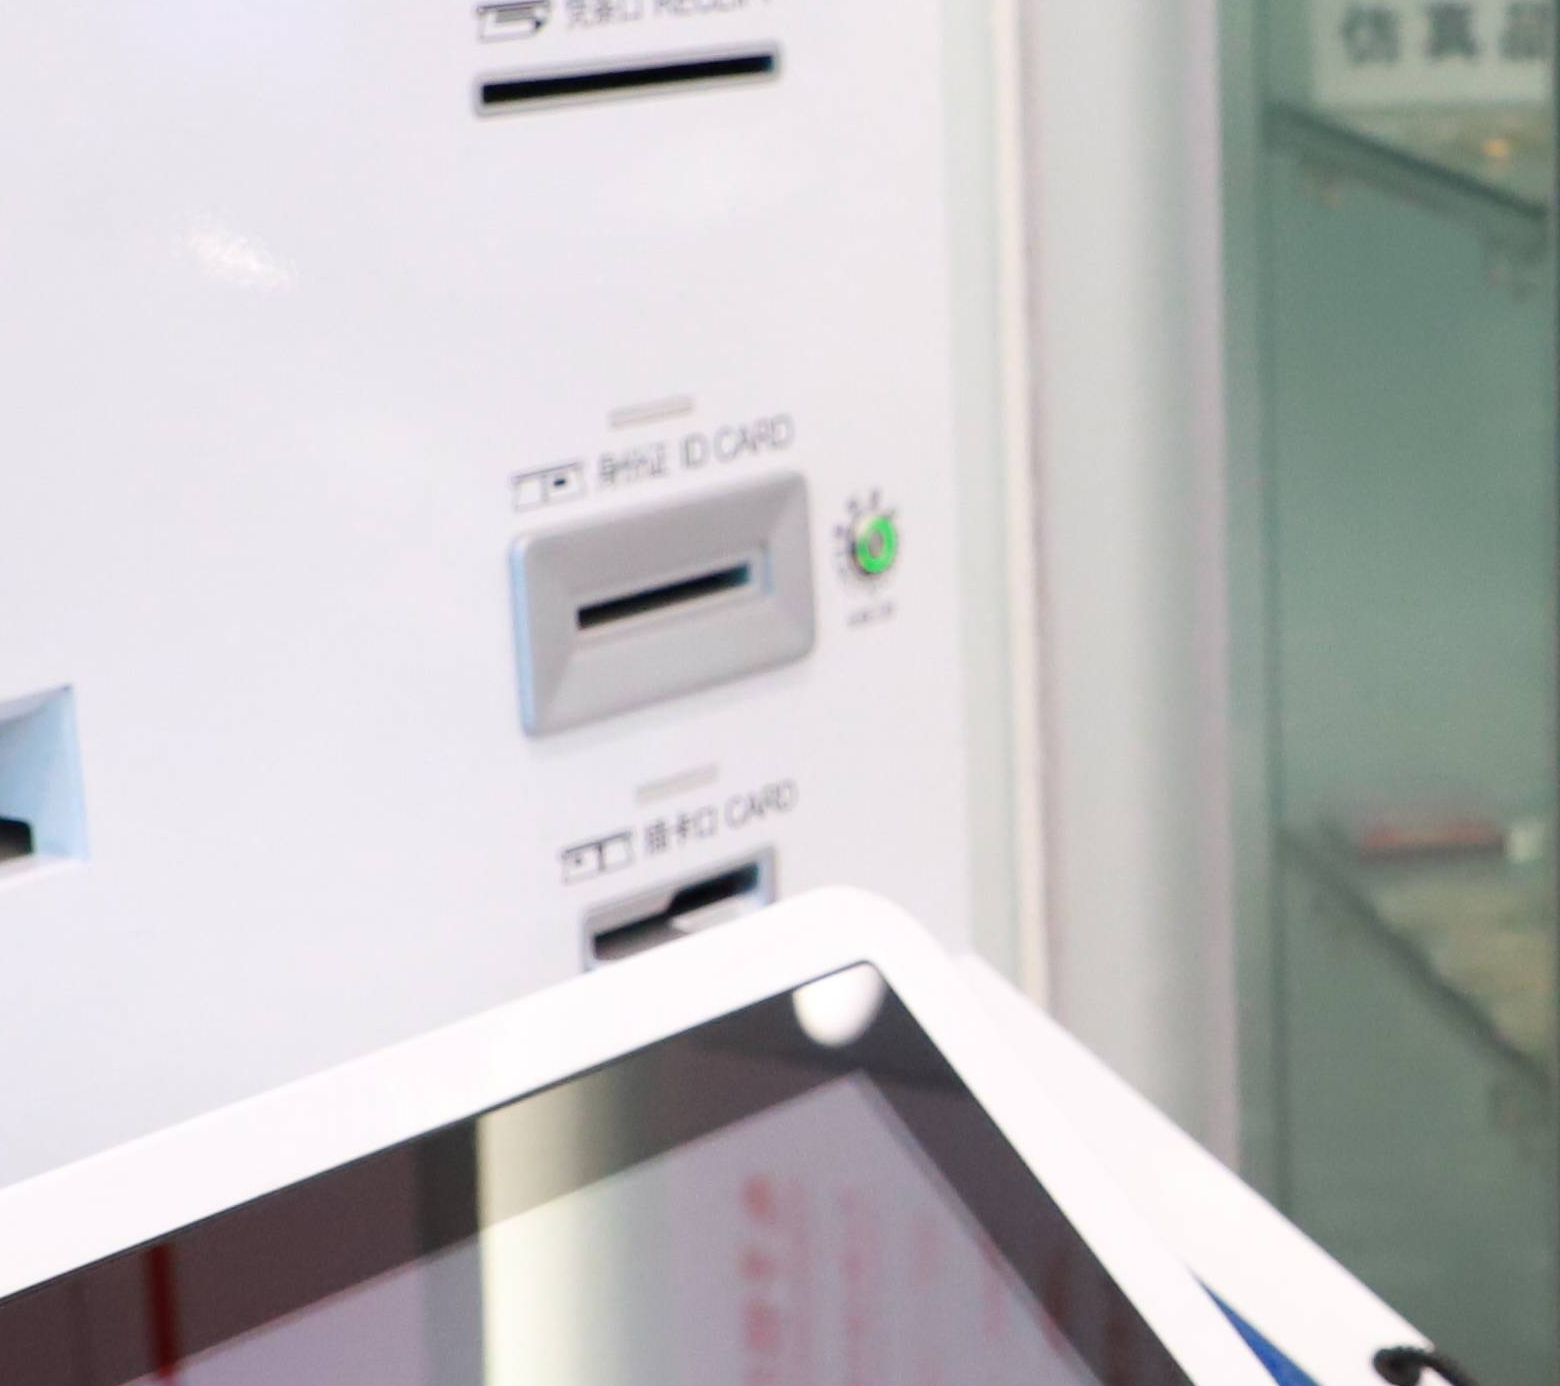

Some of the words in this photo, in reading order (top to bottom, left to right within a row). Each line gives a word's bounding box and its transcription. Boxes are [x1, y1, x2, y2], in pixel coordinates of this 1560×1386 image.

[678, 432, 711, 469] ID
[712, 413, 795, 462] CARD
[723, 778, 800, 833] CARD
